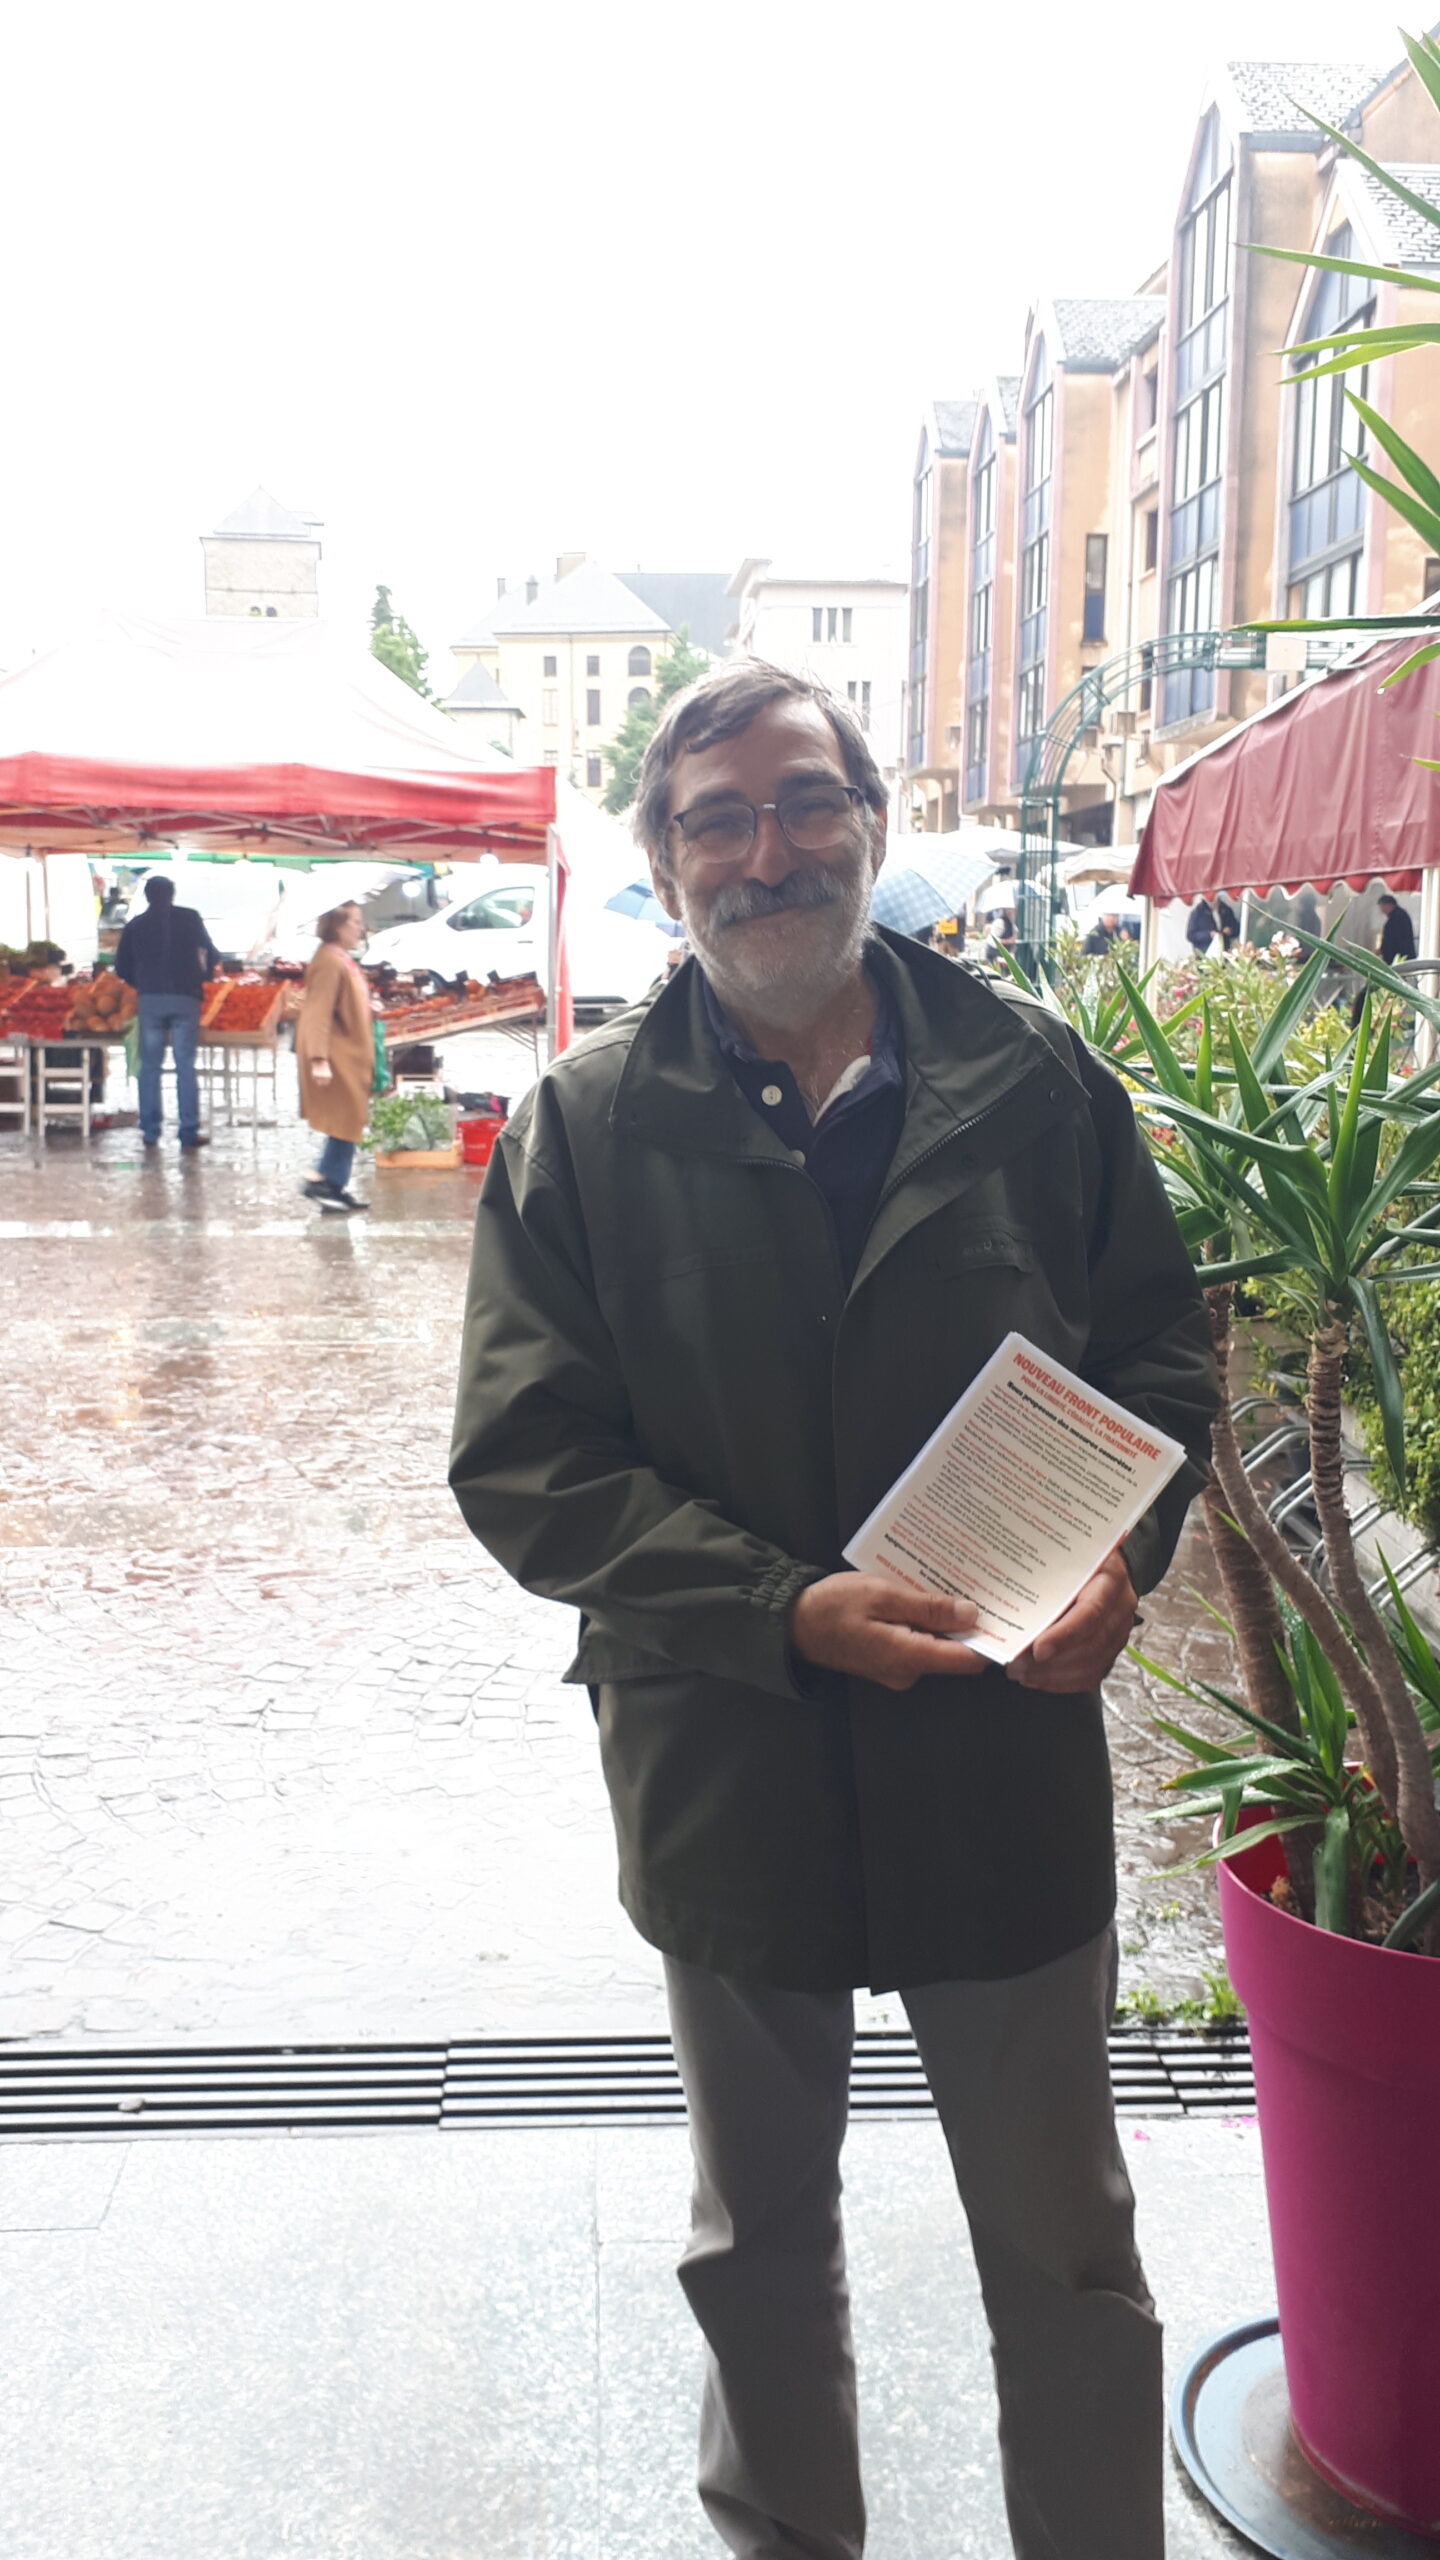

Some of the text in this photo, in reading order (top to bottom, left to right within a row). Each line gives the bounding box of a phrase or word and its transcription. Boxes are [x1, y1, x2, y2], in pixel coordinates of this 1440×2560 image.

[1005, 1379, 1025, 1397] Nous
[1020, 1392, 1058, 1422] proposons
[1055, 1416, 1071, 1430] des
[1068, 1426, 1099, 1450] mesures
[1096, 1445, 1134, 1473] concrètes
[1011, 1351, 1066, 1396] NOUVEAU
[1061, 1388, 1102, 1421] FRONT
[1096, 1413, 1162, 1461] POPULAIRE
[1019, 1373, 1038, 1390] POUR
[1035, 1385, 1046, 1396] LA
[1093, 1426, 1105, 1437] LA
[1101, 1431, 1139, 1459] FRATERNITÉ
